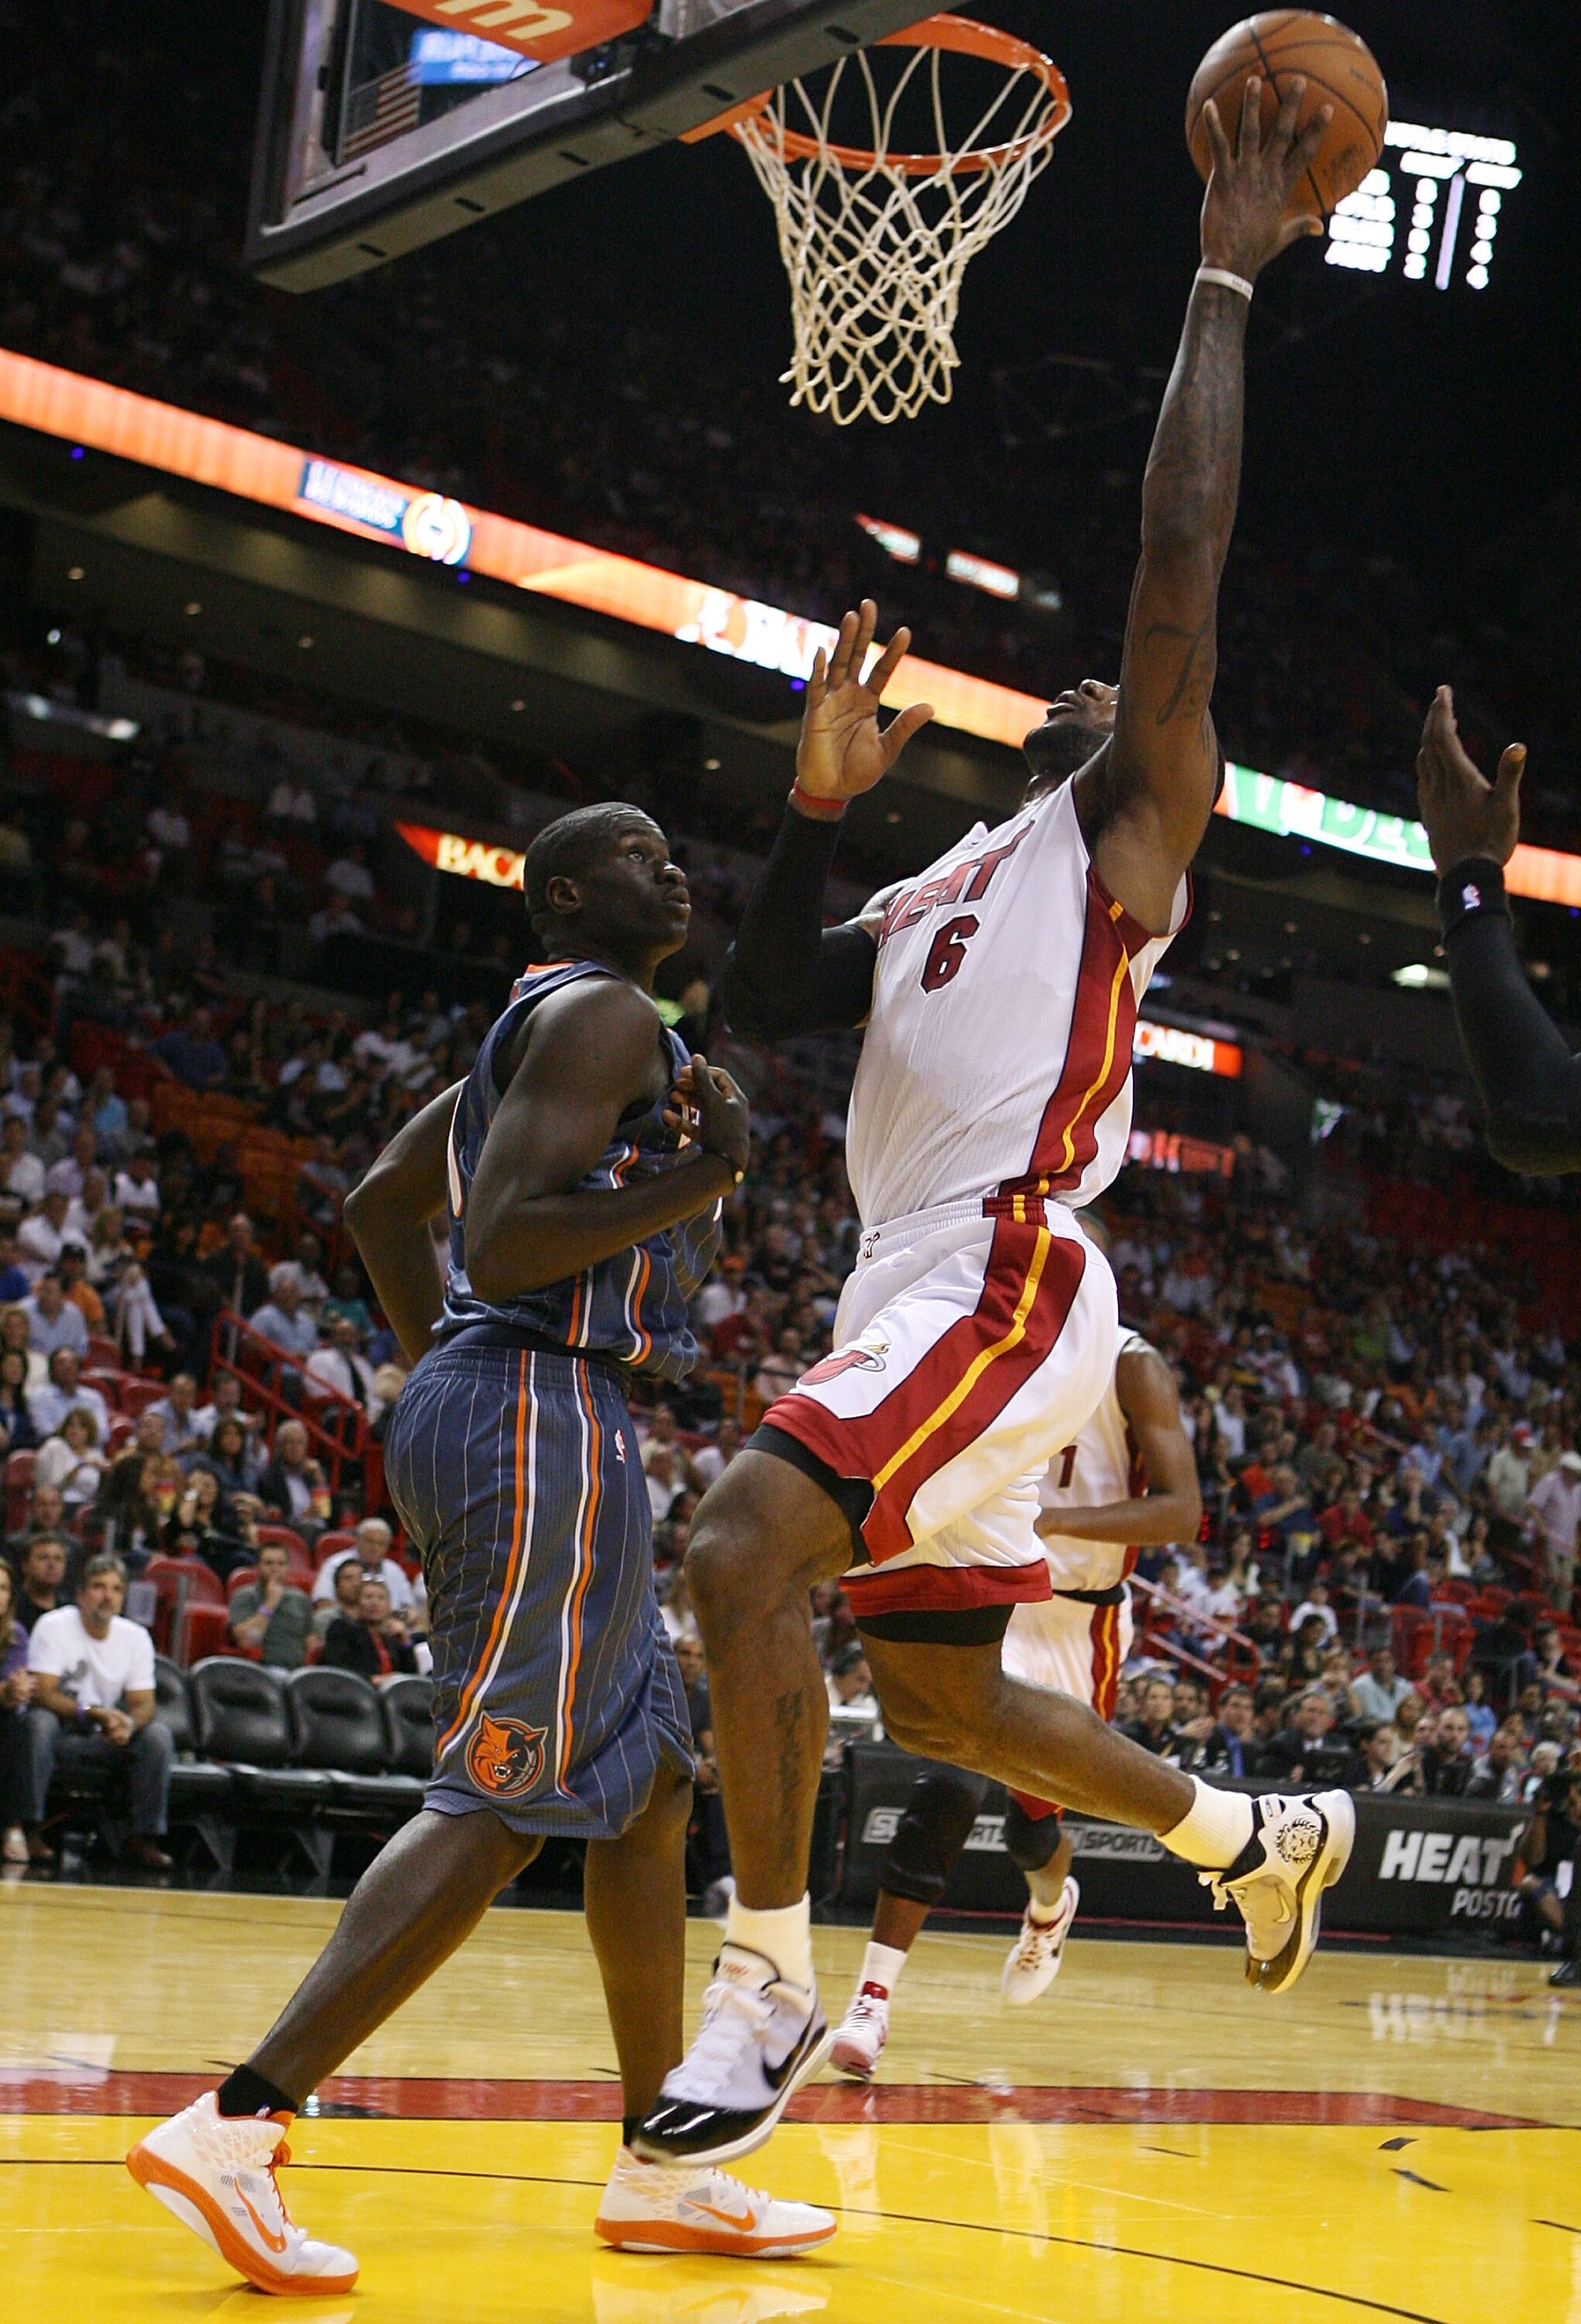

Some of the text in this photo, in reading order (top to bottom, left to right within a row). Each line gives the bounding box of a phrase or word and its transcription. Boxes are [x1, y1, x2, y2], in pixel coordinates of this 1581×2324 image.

[878, 819, 1036, 951] HEAT
[920, 913, 981, 995] 6
[1058, 1444, 1078, 1488] 1
[1084, 1831, 1162, 1853] SPORTS
[1379, 1822, 1525, 1886] HEAT
